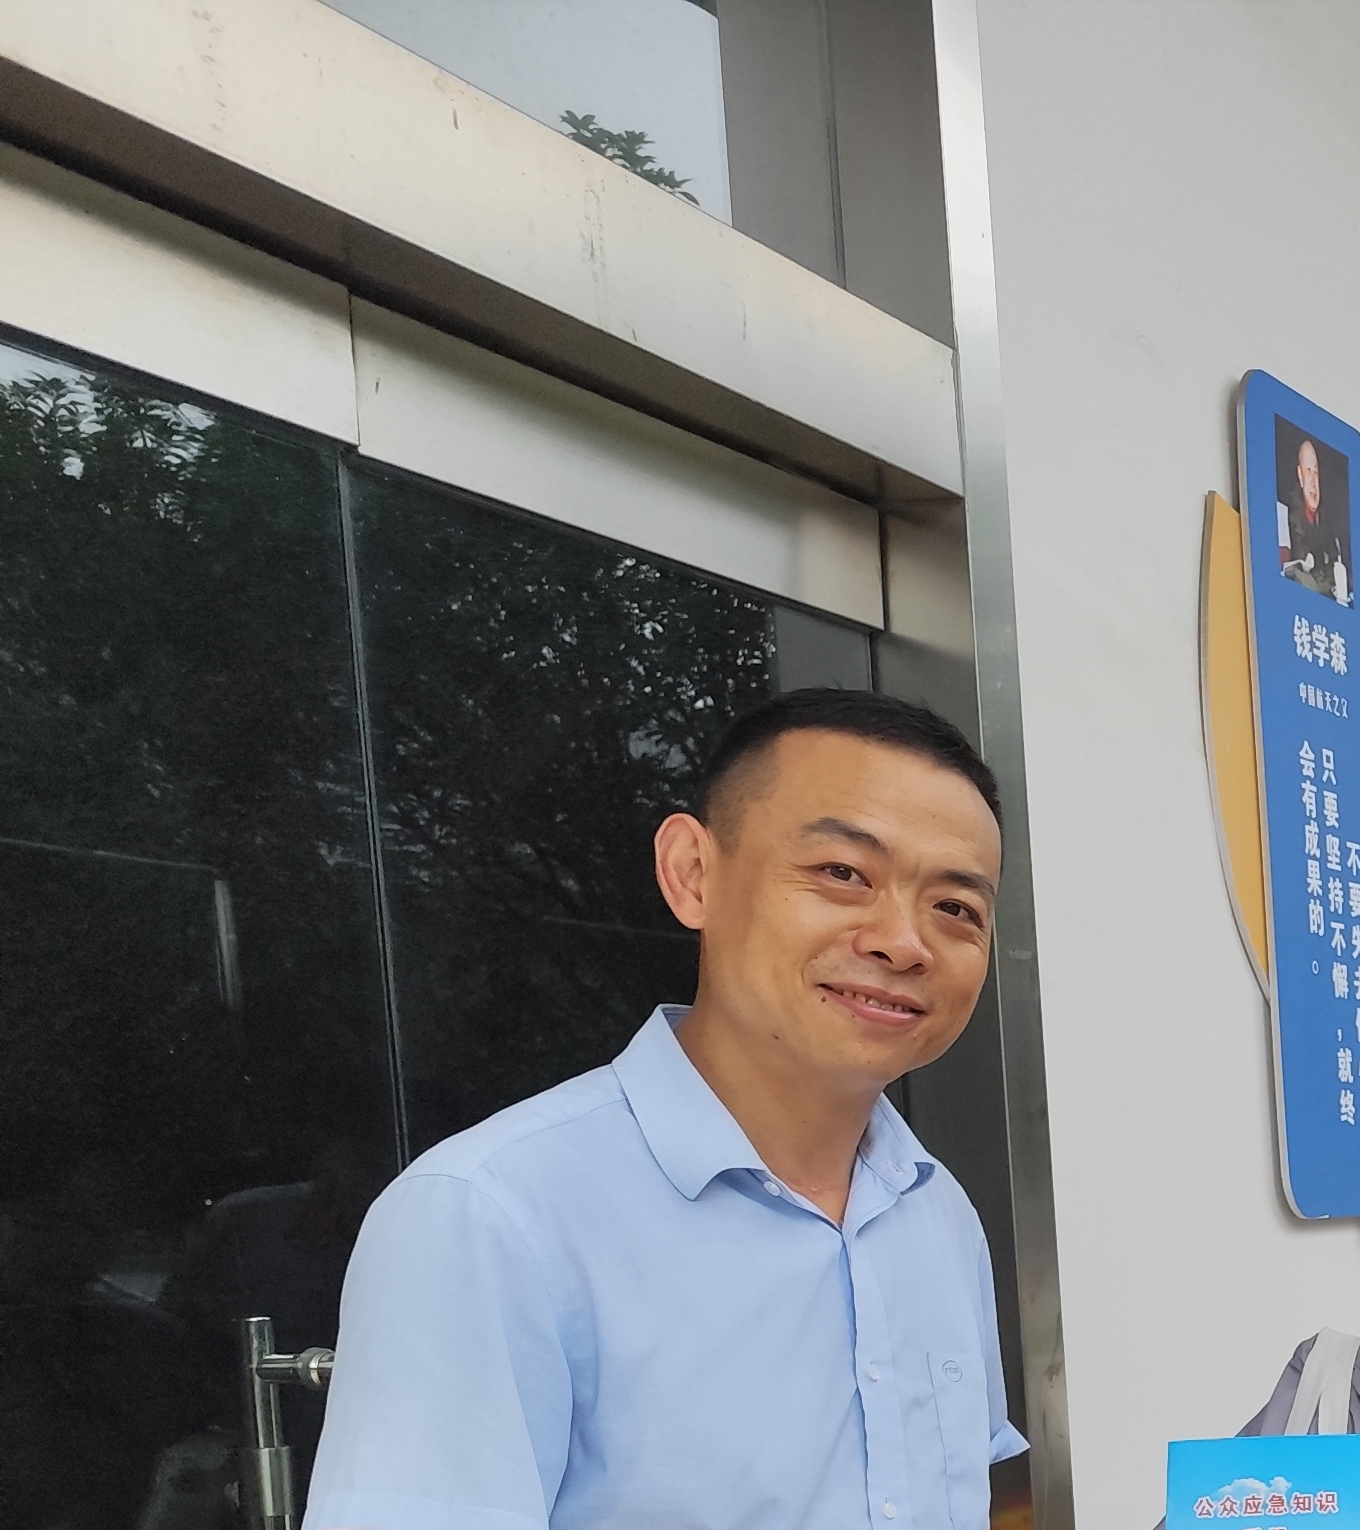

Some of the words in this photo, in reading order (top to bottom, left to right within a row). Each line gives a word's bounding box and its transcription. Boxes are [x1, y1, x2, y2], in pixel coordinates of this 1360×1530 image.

[1292, 614, 1348, 677] 钱学森
[1193, 1491, 1340, 1518] 公众应急知识
